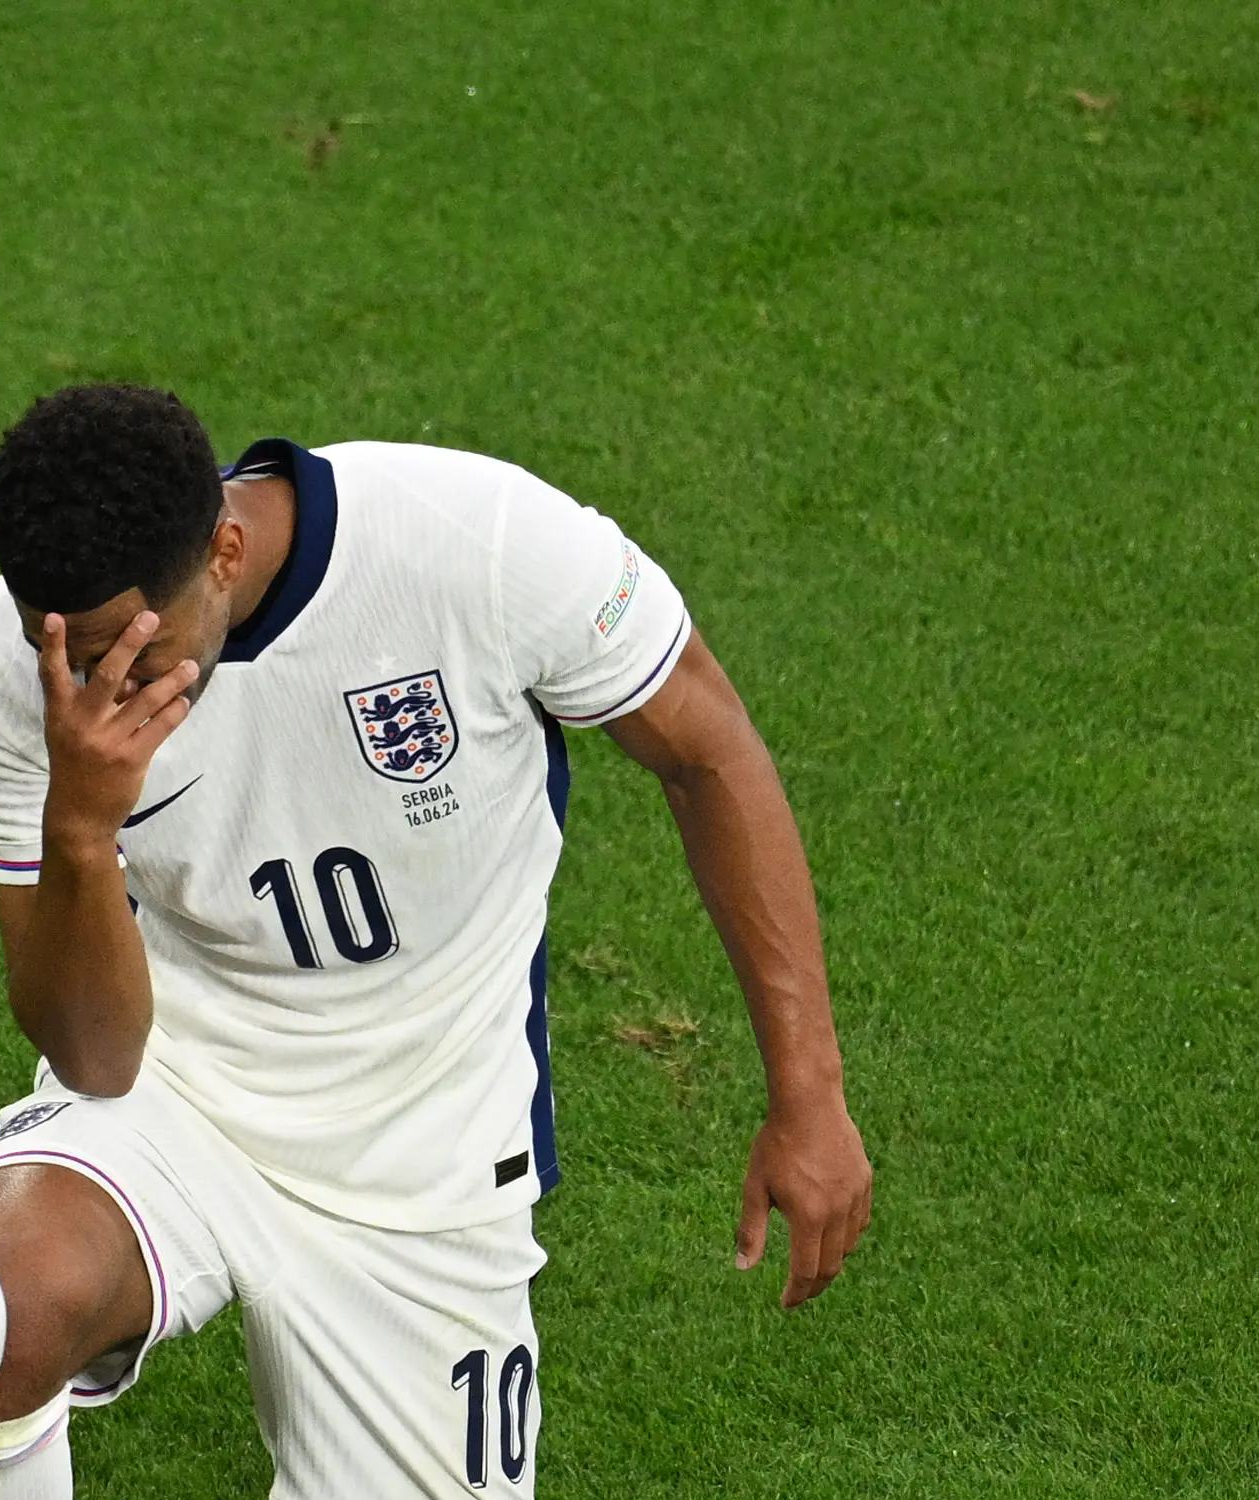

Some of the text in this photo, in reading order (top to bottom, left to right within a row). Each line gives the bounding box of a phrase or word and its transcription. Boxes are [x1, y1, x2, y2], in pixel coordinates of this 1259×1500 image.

[594, 600, 611, 625] UEFA
[401, 783, 454, 808] SERBIA
[405, 799, 460, 827] 16.06.24
[249, 847, 400, 970] 10
[451, 1343, 535, 1489] 10
